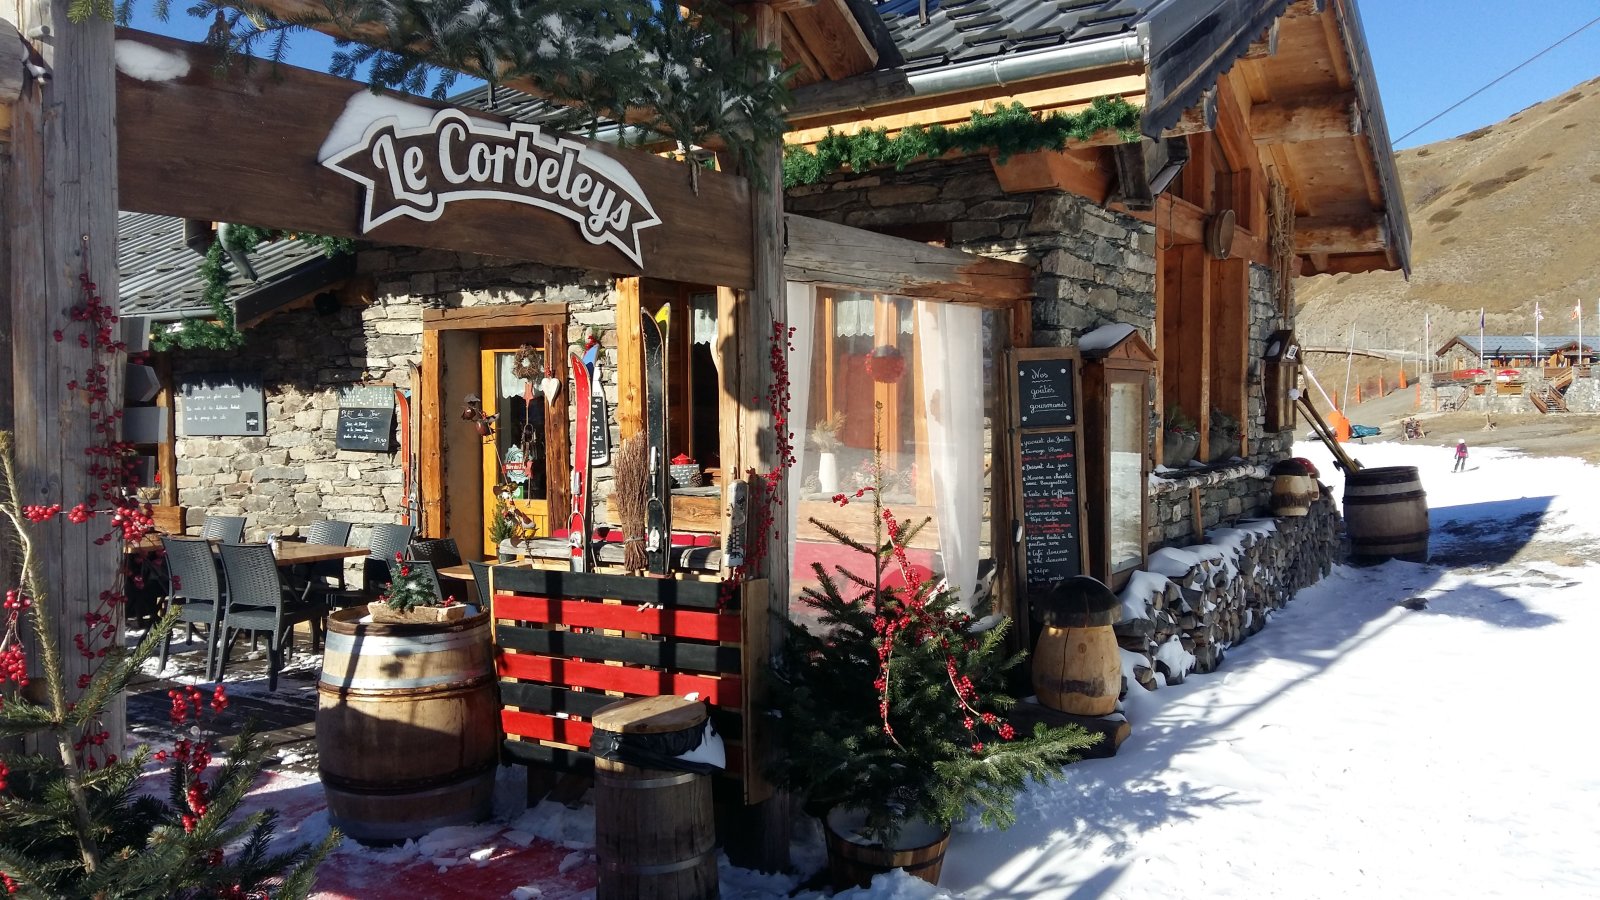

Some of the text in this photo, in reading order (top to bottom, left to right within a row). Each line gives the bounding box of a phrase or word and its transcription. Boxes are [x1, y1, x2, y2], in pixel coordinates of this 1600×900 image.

[373, 122, 631, 232] Le Corbeleys
[1031, 368, 1048, 379] Nos
[1030, 401, 1067, 414] gourmands
